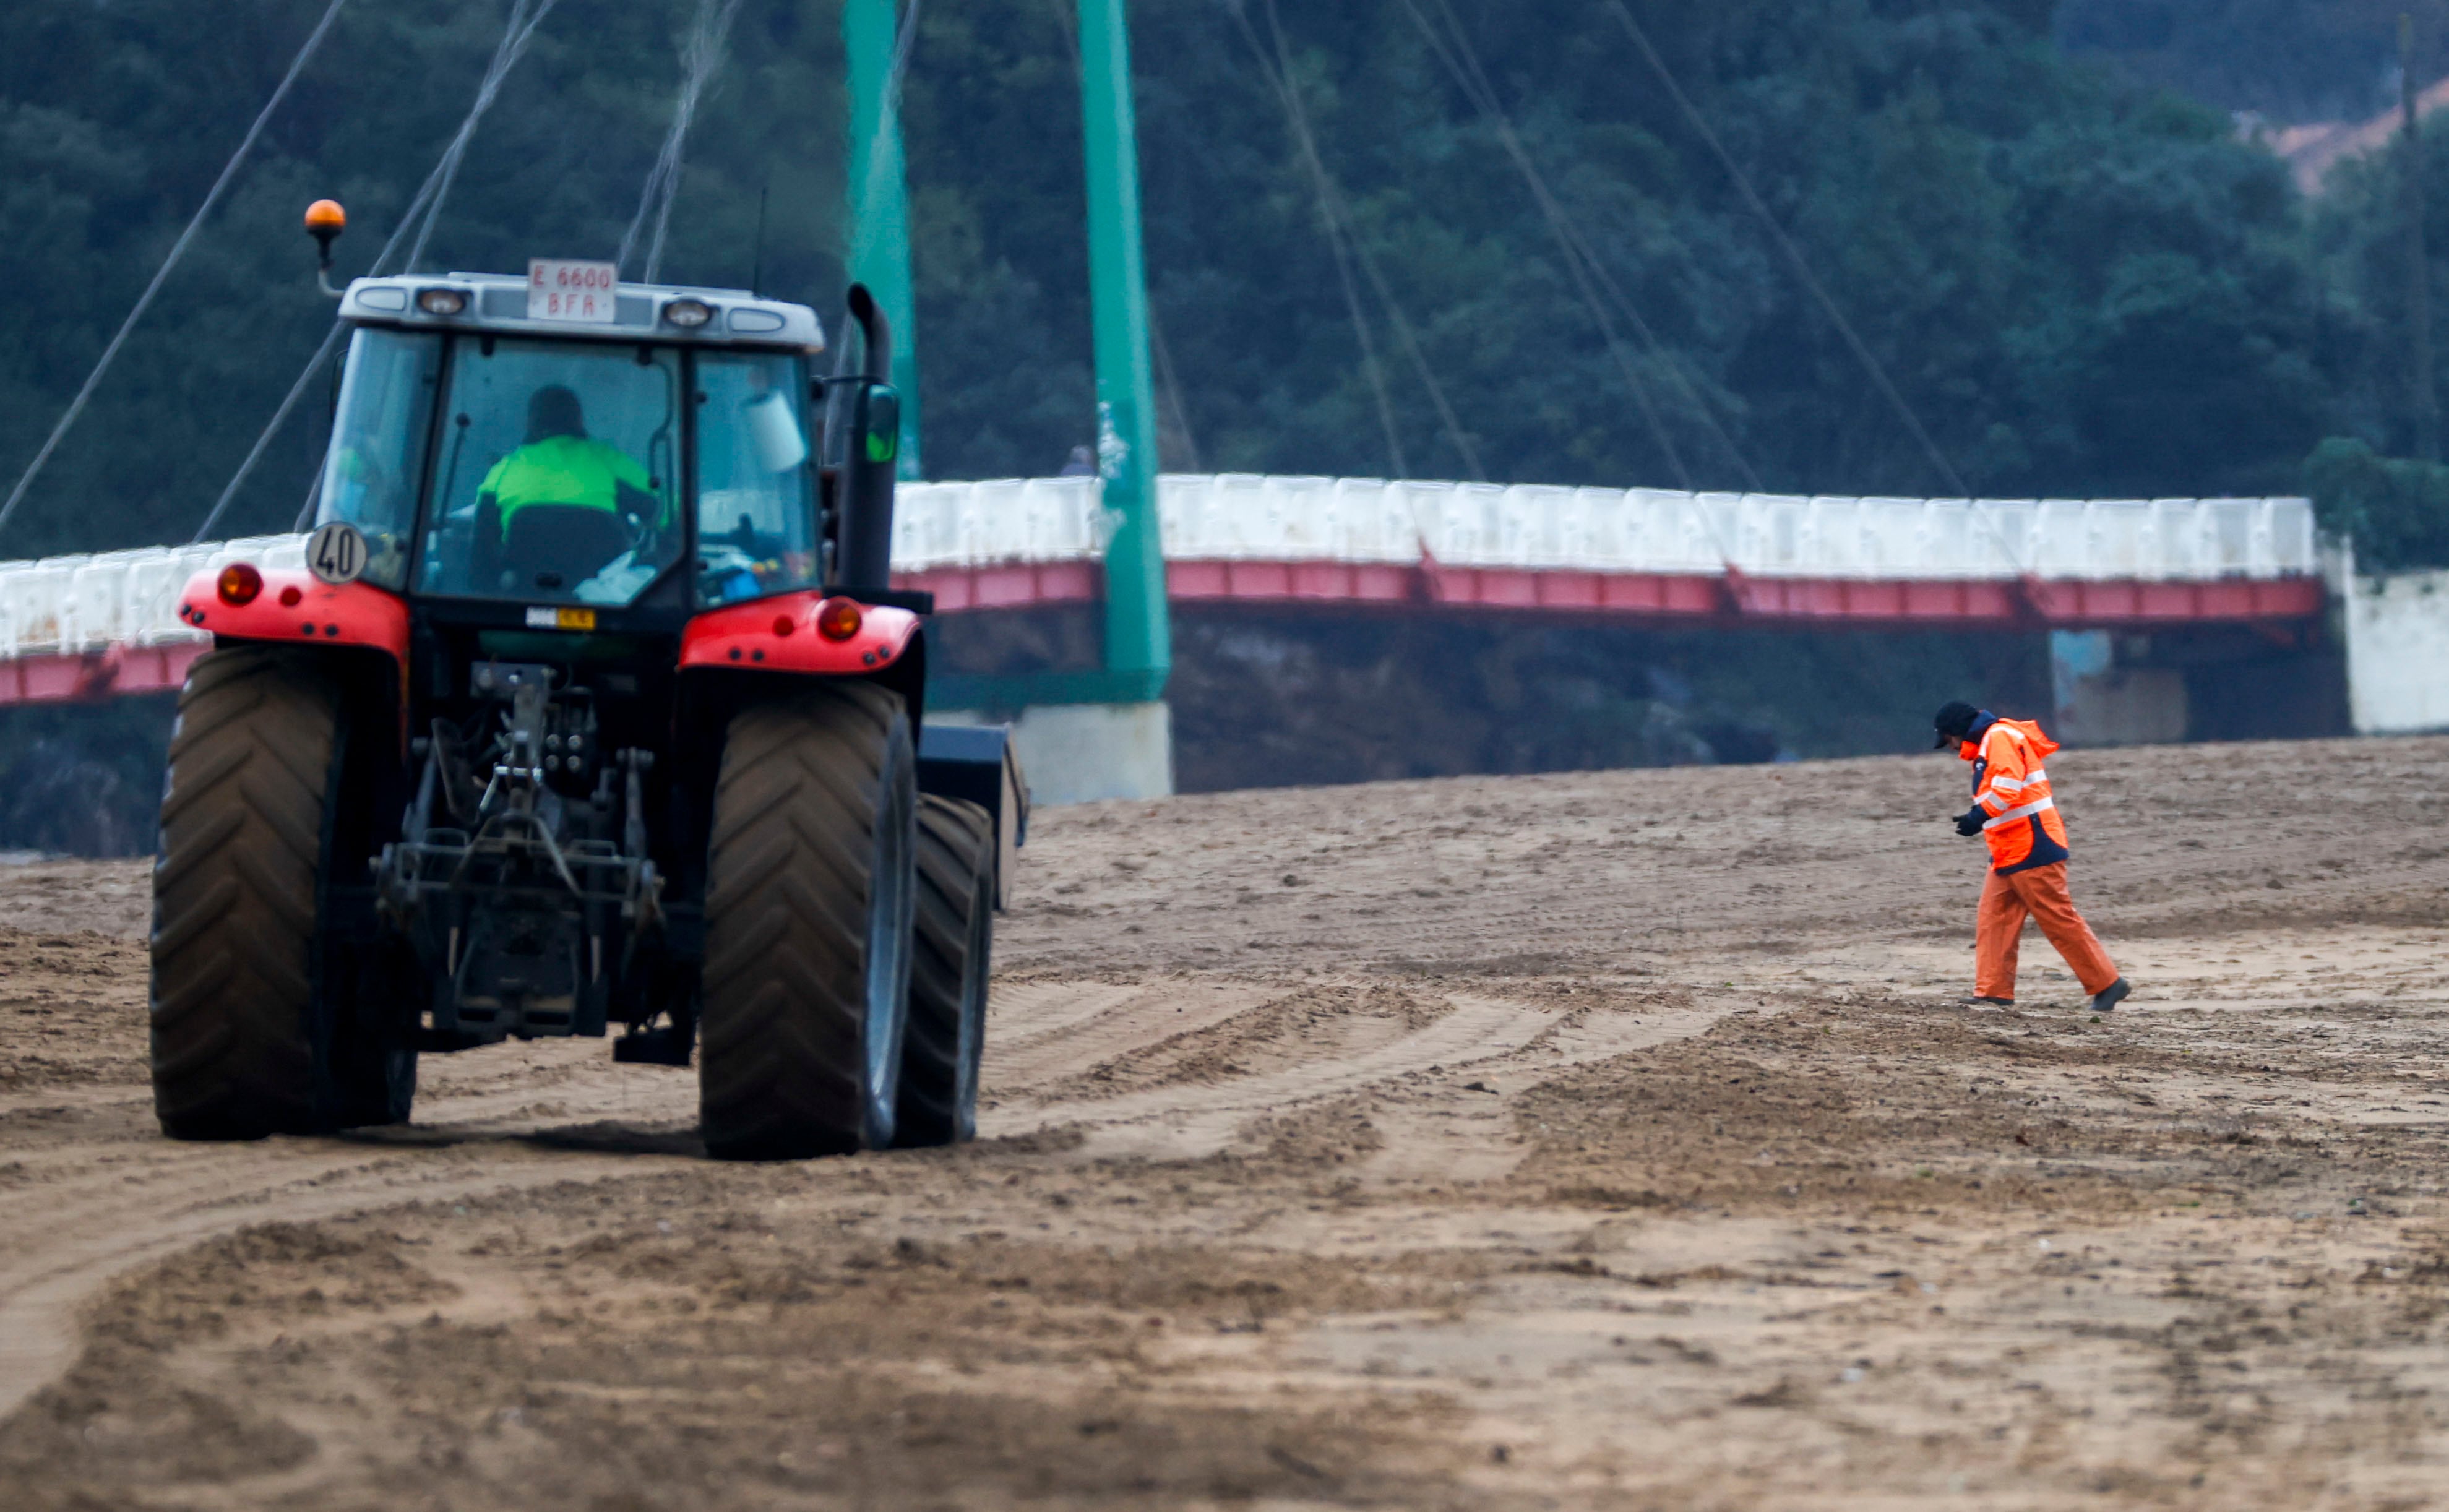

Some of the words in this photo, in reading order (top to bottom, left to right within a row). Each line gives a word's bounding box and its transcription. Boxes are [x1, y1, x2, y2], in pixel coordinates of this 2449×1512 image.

[533, 265, 544, 286] E
[557, 267, 611, 290] 6600
[316, 526, 354, 575] 40
